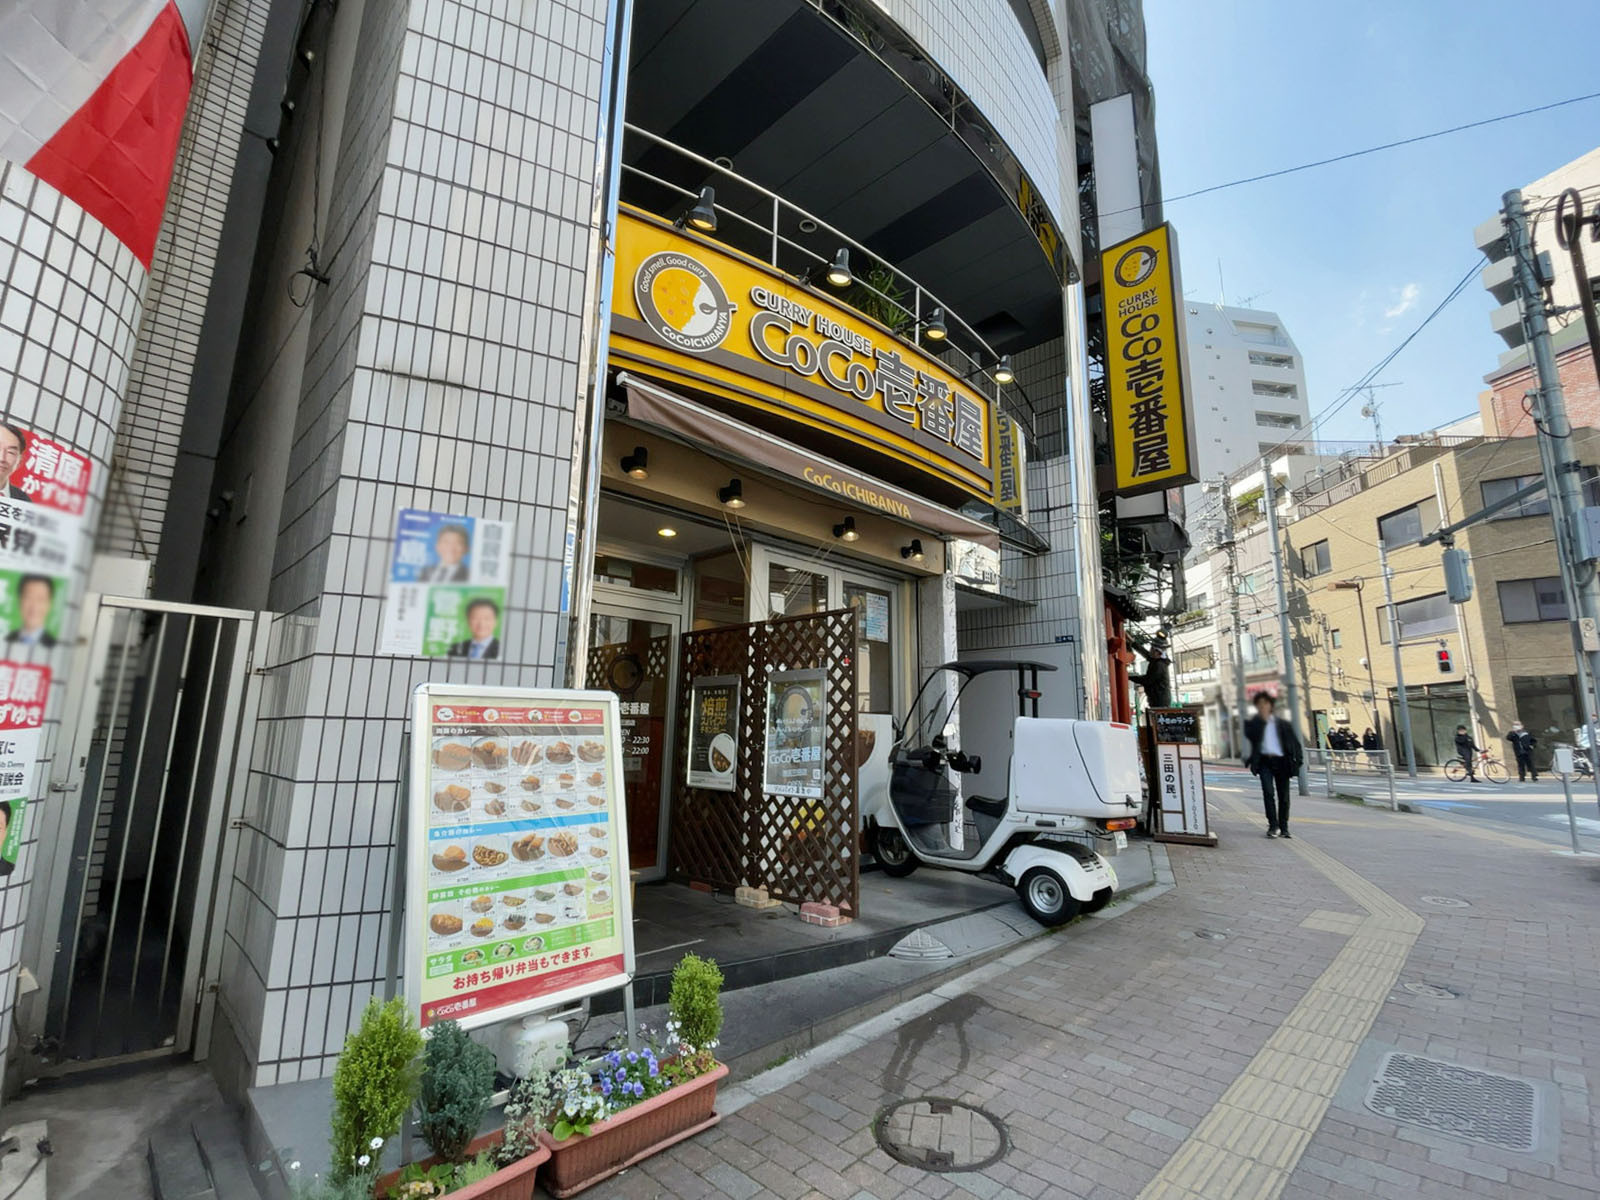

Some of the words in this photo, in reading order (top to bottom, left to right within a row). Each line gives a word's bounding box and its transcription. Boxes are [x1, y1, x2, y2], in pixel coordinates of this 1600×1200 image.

[640, 269, 652, 293] Good
[665, 256, 687, 268] Good
[687, 262, 708, 279] curry
[1118, 288, 1157, 308] CURRY
[1118, 297, 1158, 318] HOUSE
[751, 286, 815, 327] CURRY
[816, 313, 873, 358] HOUSE
[1120, 313, 1160, 338] Co
[1122, 336, 1162, 361] Co
[25, 438, 84, 486] 清原
[632, 736, 650, 744] 22:30
[632, 747, 650, 755] 22:00
